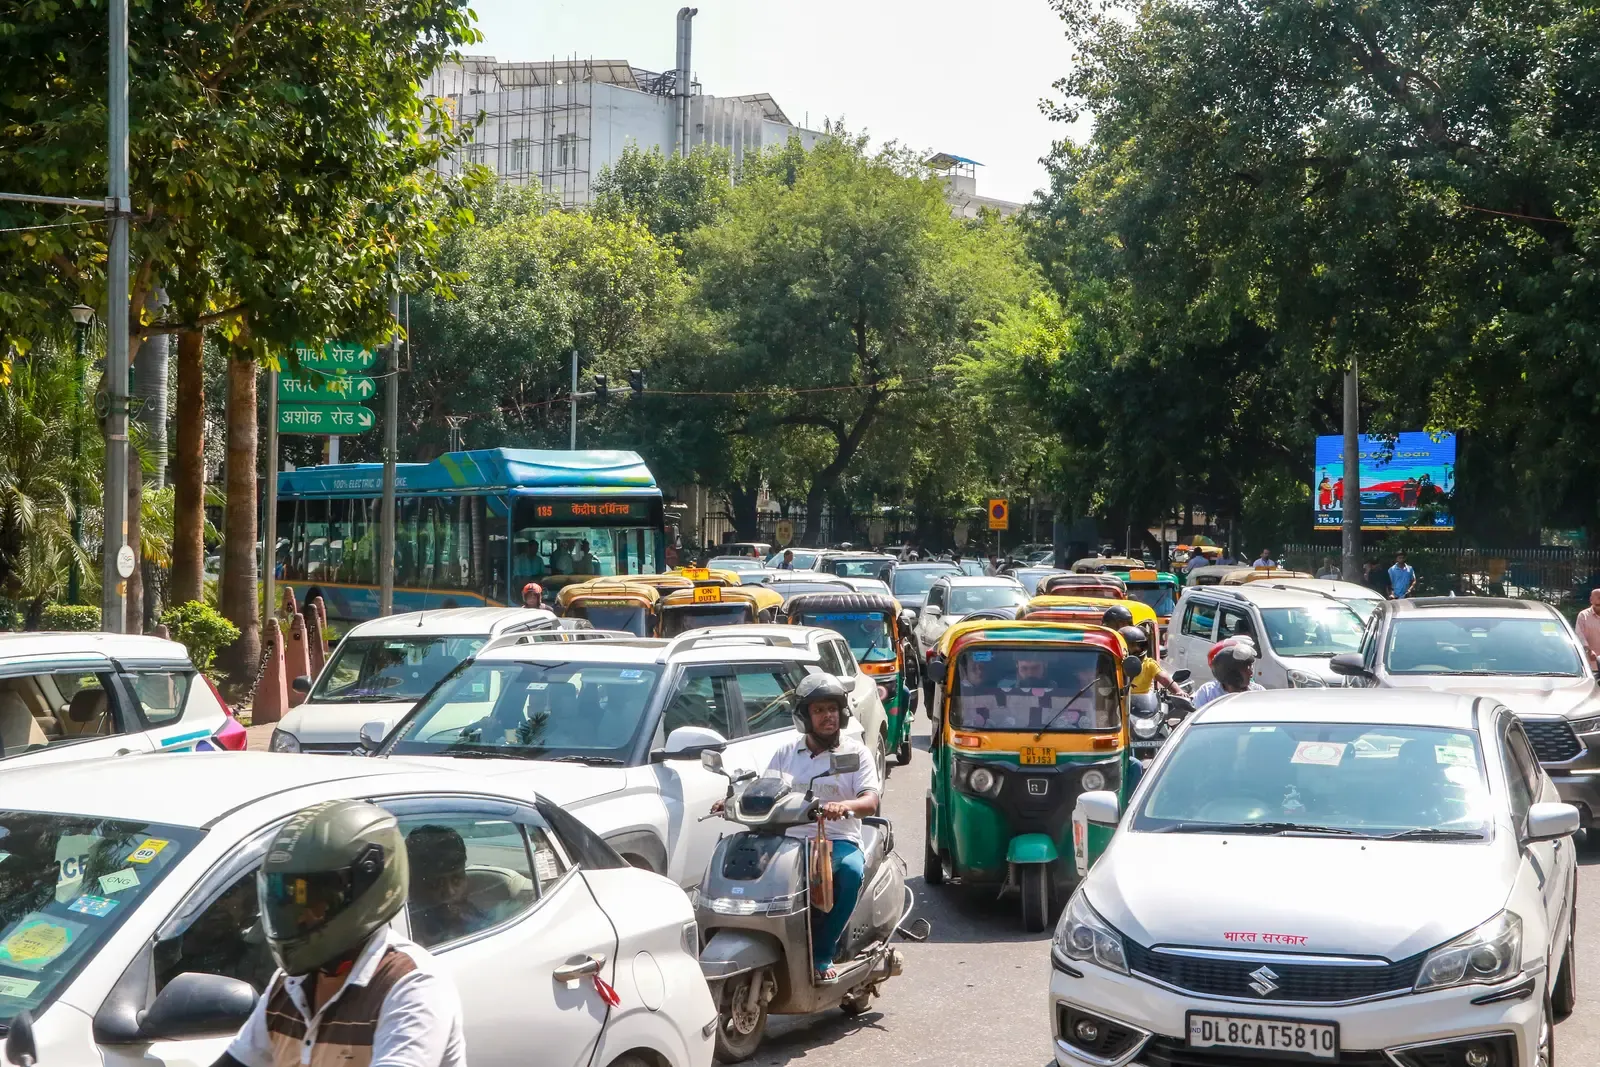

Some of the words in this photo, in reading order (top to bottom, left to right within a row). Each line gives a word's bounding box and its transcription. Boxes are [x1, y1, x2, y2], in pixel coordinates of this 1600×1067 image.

[331, 344, 356, 362] रोड
[281, 406, 323, 425] अशोक
[330, 406, 354, 425] रोड
[536, 506, 553, 517] 185
[1026, 748, 1036, 756] DL
[1042, 748, 1051, 756] 1R
[106, 876, 132, 886] CNG
[1223, 931, 1258, 943] भारत
[1262, 932, 1308, 946] सरकार
[1202, 1020, 1333, 1051] DL8CAT5810
